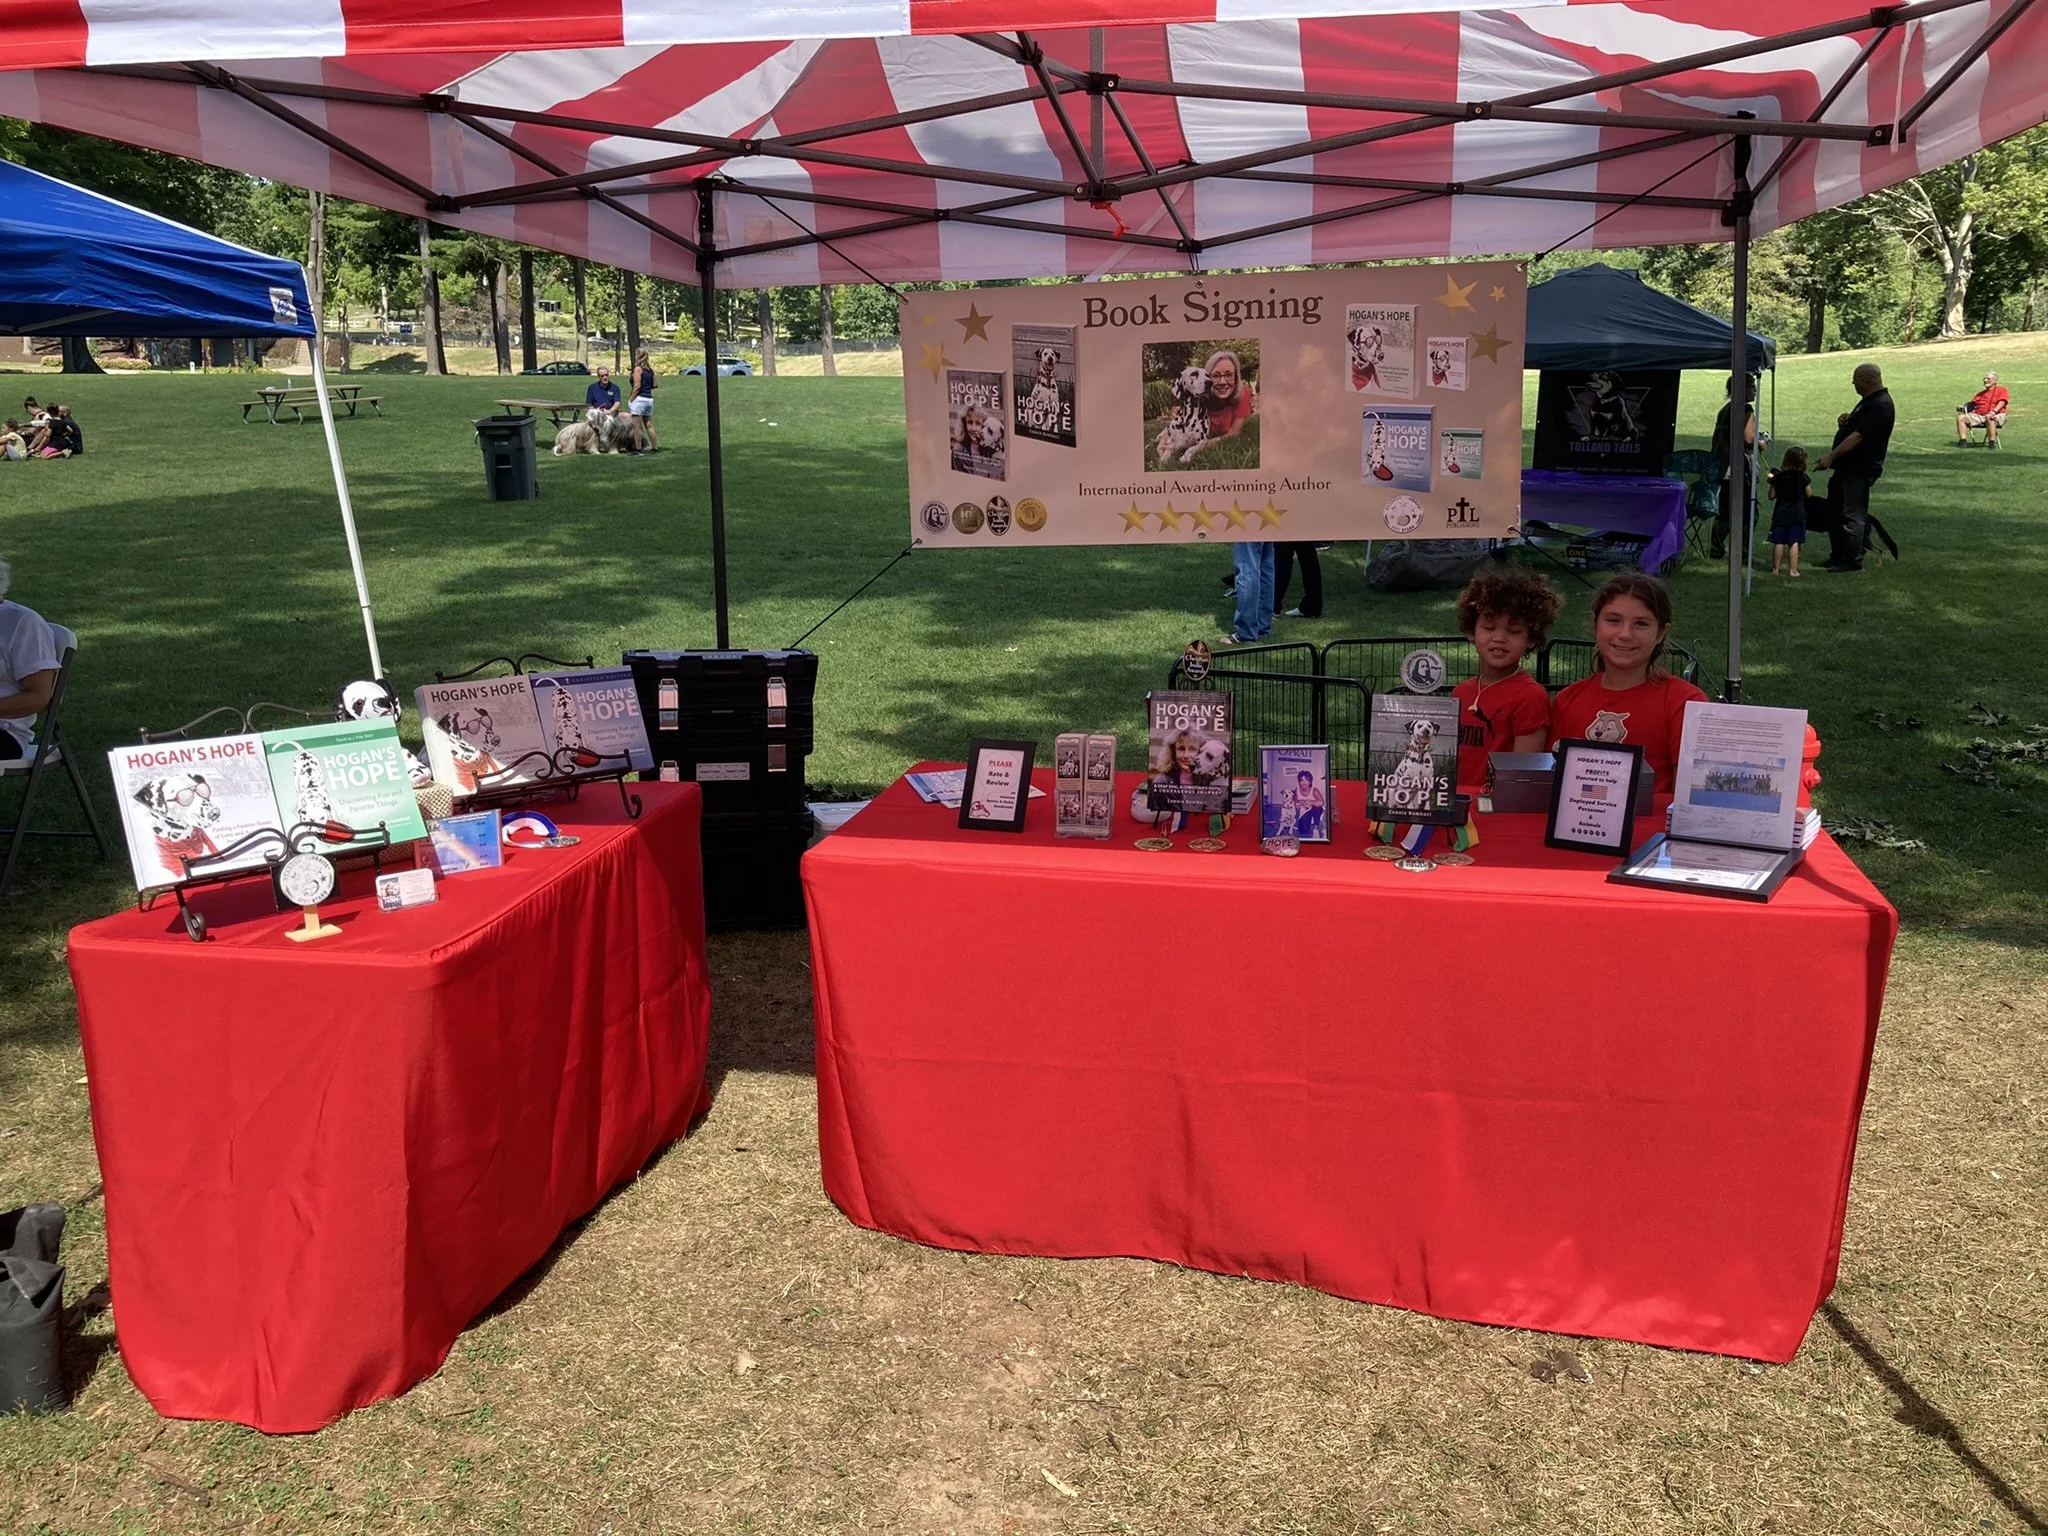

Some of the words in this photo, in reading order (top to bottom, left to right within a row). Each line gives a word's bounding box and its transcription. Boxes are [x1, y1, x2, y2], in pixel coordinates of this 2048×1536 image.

[1083, 294, 1170, 327] Book
[1183, 289, 1323, 327] Signing
[1349, 310, 1385, 321] HOGAN'S
[1386, 311, 1411, 322] HOPE
[950, 382, 998, 399] HOGAN'S
[950, 392, 1000, 410] HOPE
[1017, 395, 1071, 416] HOGAN'S
[1017, 408, 1071, 431] HOPE
[1387, 425, 1428, 436] HOGAN'S
[1387, 435, 1428, 451] HOPE
[1456, 446, 1481, 456] HOPE
[1569, 441, 1611, 453] TOLLAND
[1613, 442, 1641, 454] TAILS
[1079, 481, 1167, 497] International
[1170, 478, 1276, 495] Award-winning
[1279, 476, 1332, 491] Author
[431, 686, 489, 703] HOGAN'S
[490, 682, 526, 699] HOPE
[576, 687, 636, 704] HOGAN'S
[579, 699, 640, 723] HOPE
[1156, 704, 1225, 717] HOGAN'S
[1155, 716, 1225, 732] HOPE
[127, 747, 207, 769] HOGAN'S
[209, 741, 257, 760] HOPE
[323, 746, 397, 768] HOGAN'S
[1576, 756, 1604, 765] HOGAN'S
[1605, 758, 1622, 767] HOPE
[989, 760, 1013, 768] PLEASE
[327, 760, 403, 791] HOPE
[986, 779, 1010, 788] Review
[1373, 773, 1449, 790] HOGAN'S
[1373, 788, 1449, 807] HOPE
[1569, 797, 1596, 806] Deployed
[1578, 806, 1606, 814] Personnel
[1578, 821, 1601, 829] Animals
[1268, 838, 1295, 848] HOPE
